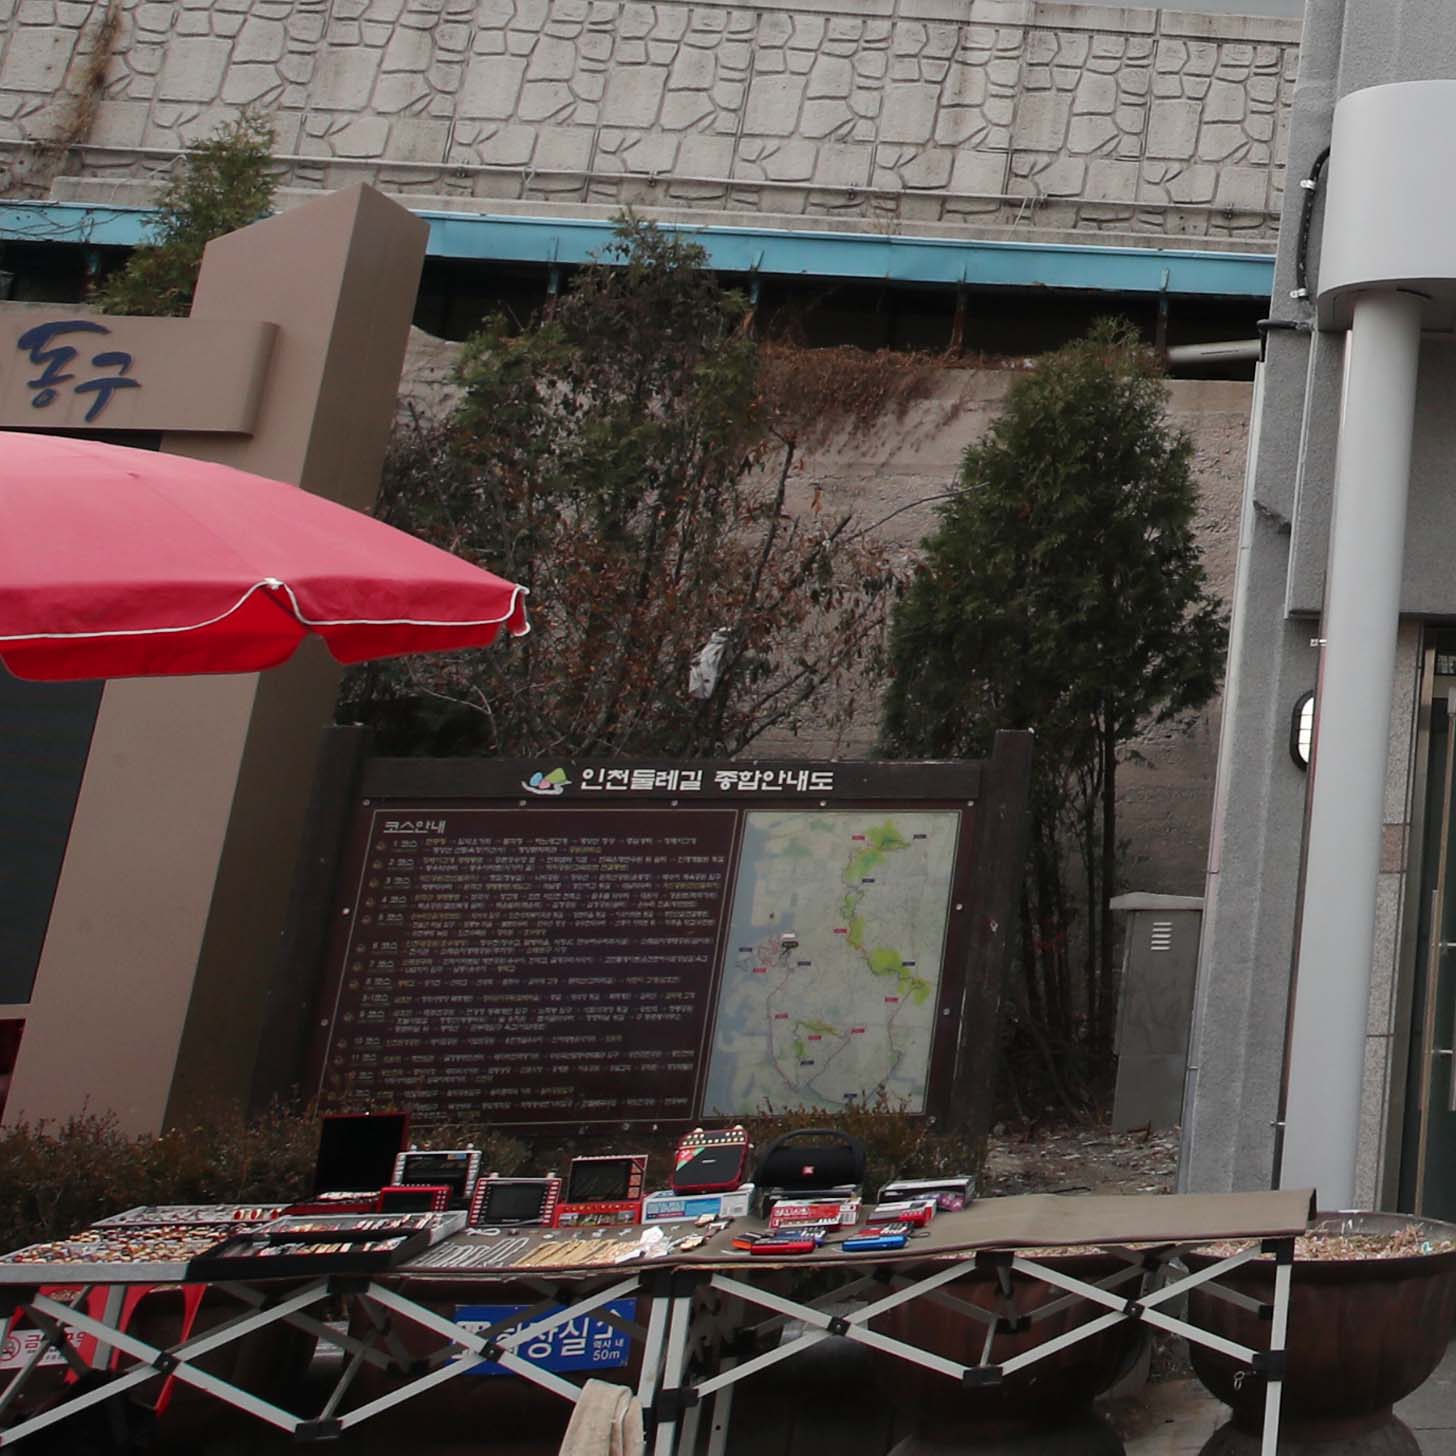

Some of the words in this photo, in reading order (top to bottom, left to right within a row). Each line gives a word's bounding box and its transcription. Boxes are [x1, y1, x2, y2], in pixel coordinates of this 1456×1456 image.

[17, 319, 143, 424] 동구
[580, 767, 703, 791] 인천둘레길
[714, 769, 835, 792] 종합안내도
[383, 820, 447, 835] 코스안내
[592, 1349, 621, 1361] 50m
